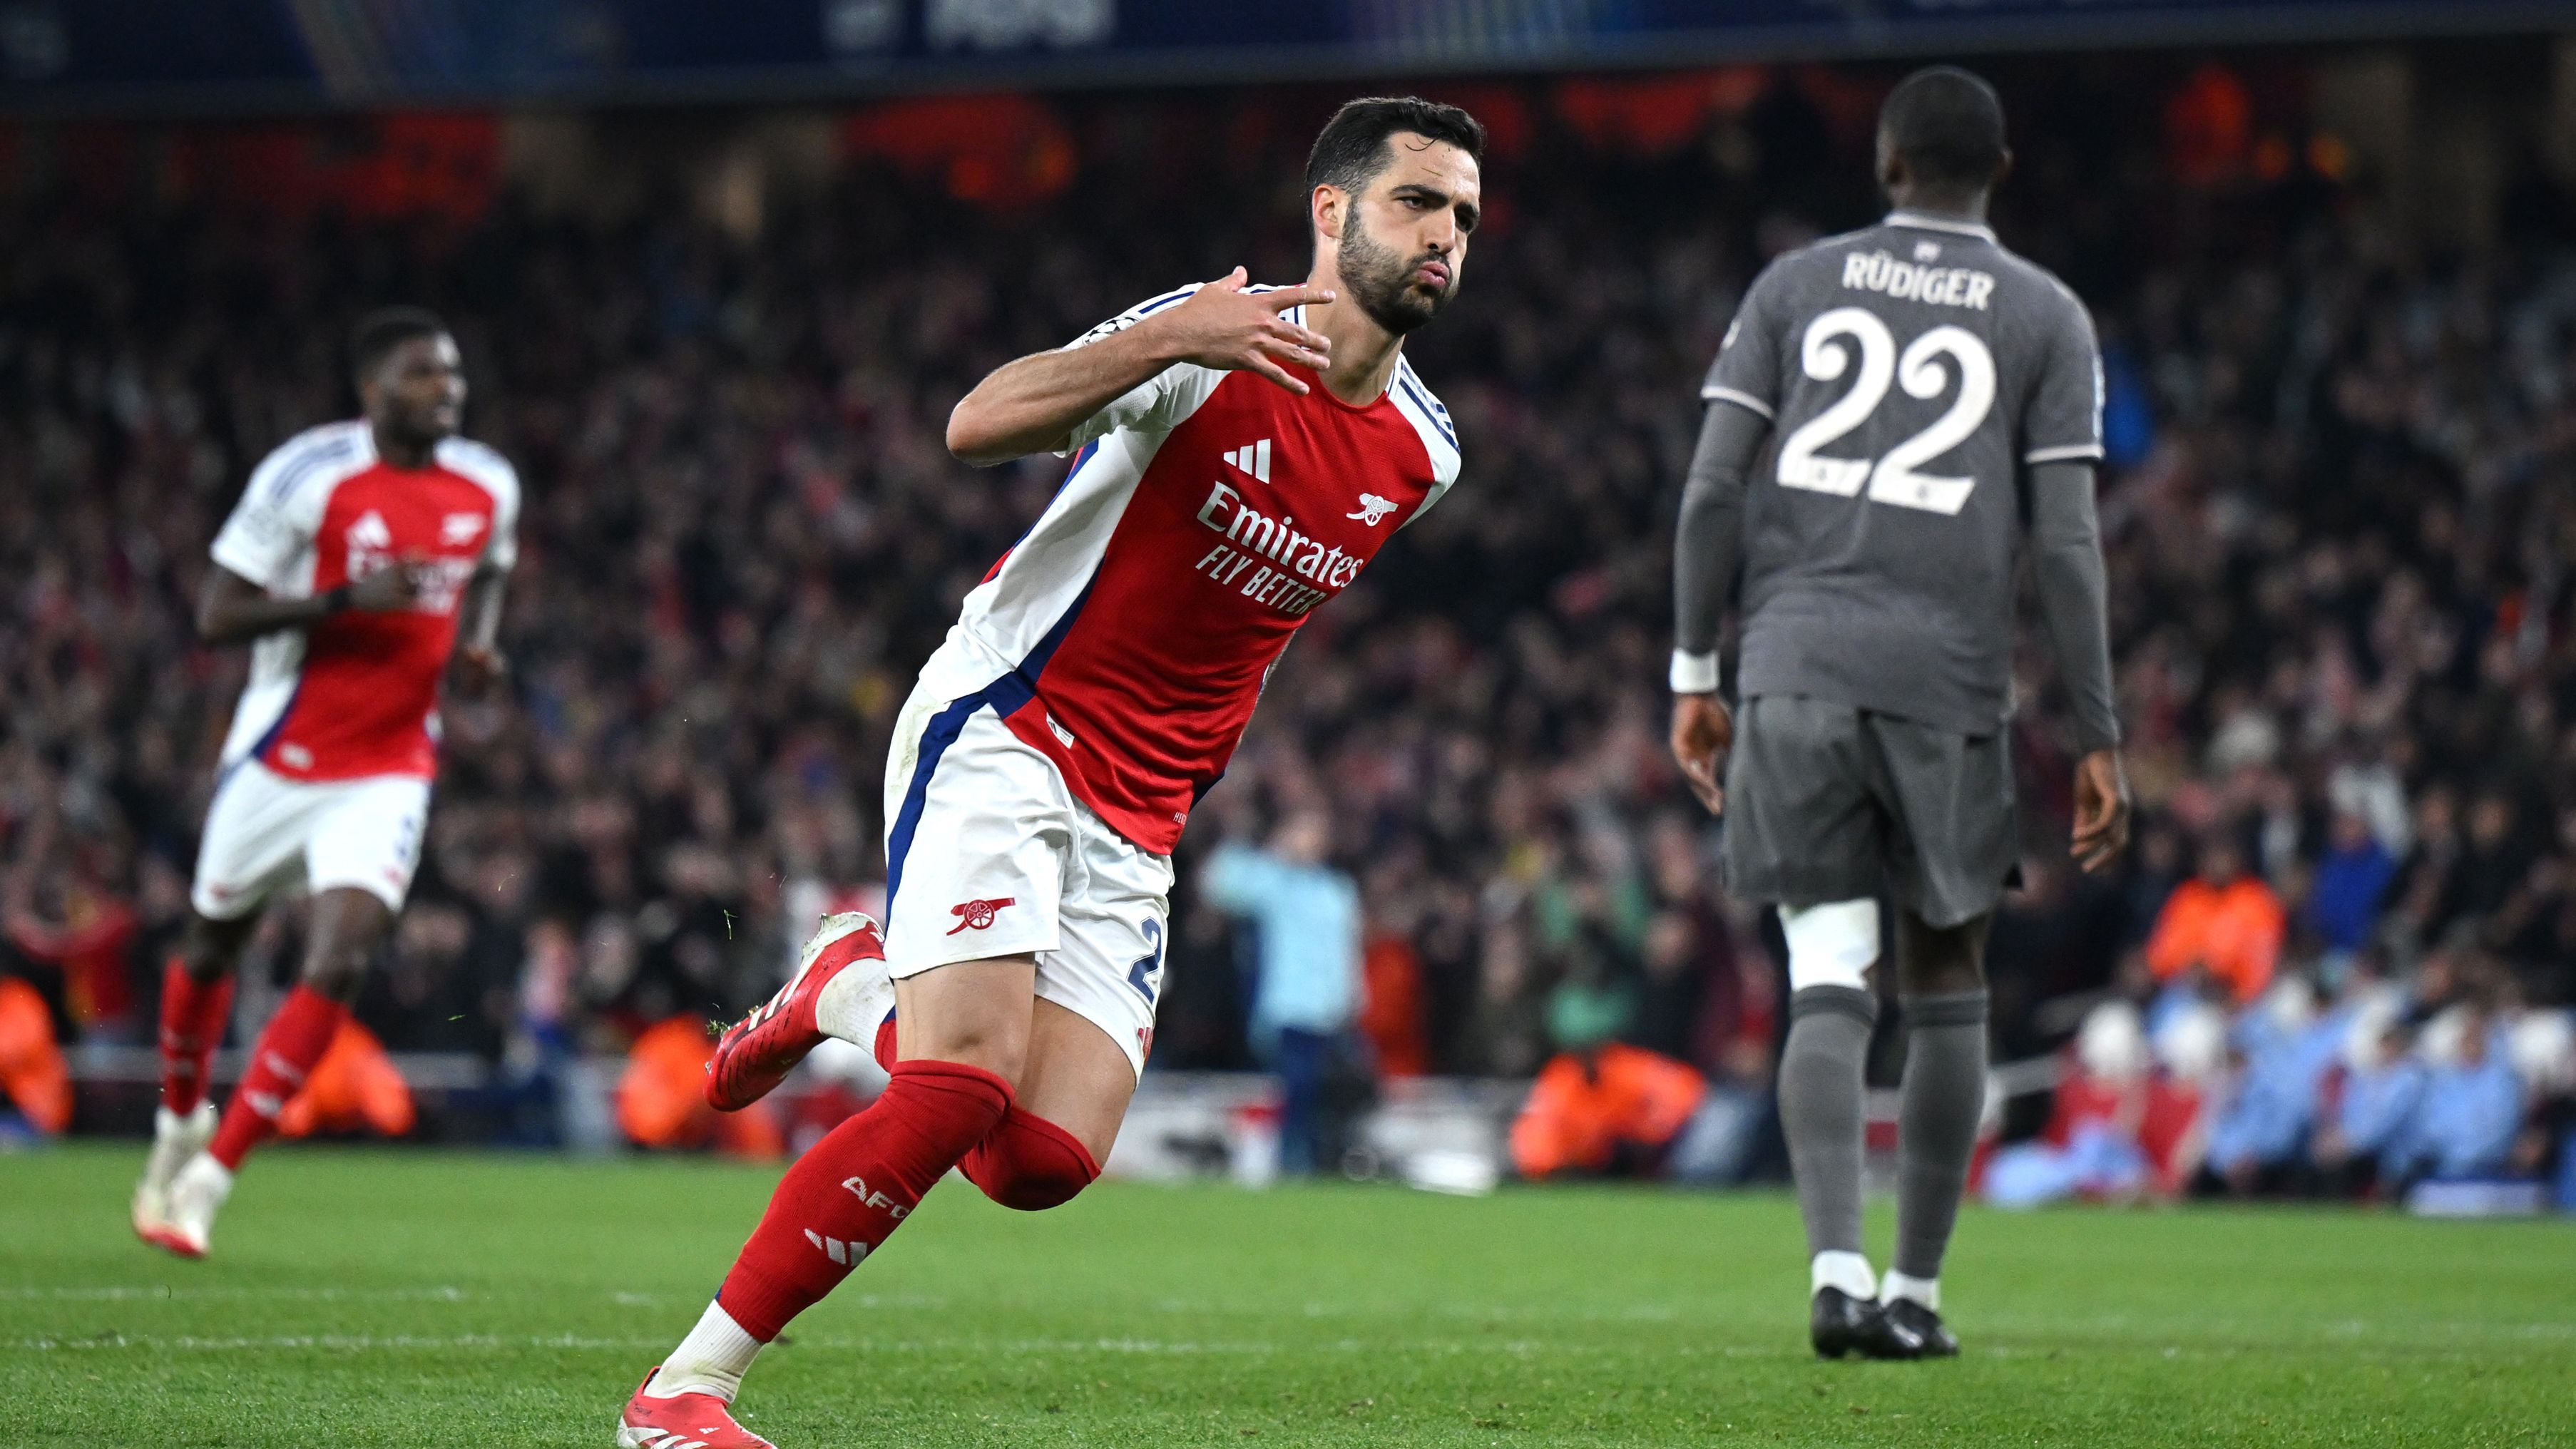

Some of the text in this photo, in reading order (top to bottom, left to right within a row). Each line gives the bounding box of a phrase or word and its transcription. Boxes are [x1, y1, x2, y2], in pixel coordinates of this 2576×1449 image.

[1842, 249, 1995, 310] RÜDIGER
[1777, 307, 1996, 516] 22
[1197, 481, 1364, 588] Emirates
[1195, 544, 1327, 615] FLY BETTER
[1125, 916, 1162, 1005] 2
[842, 1176, 911, 1219] AFC
